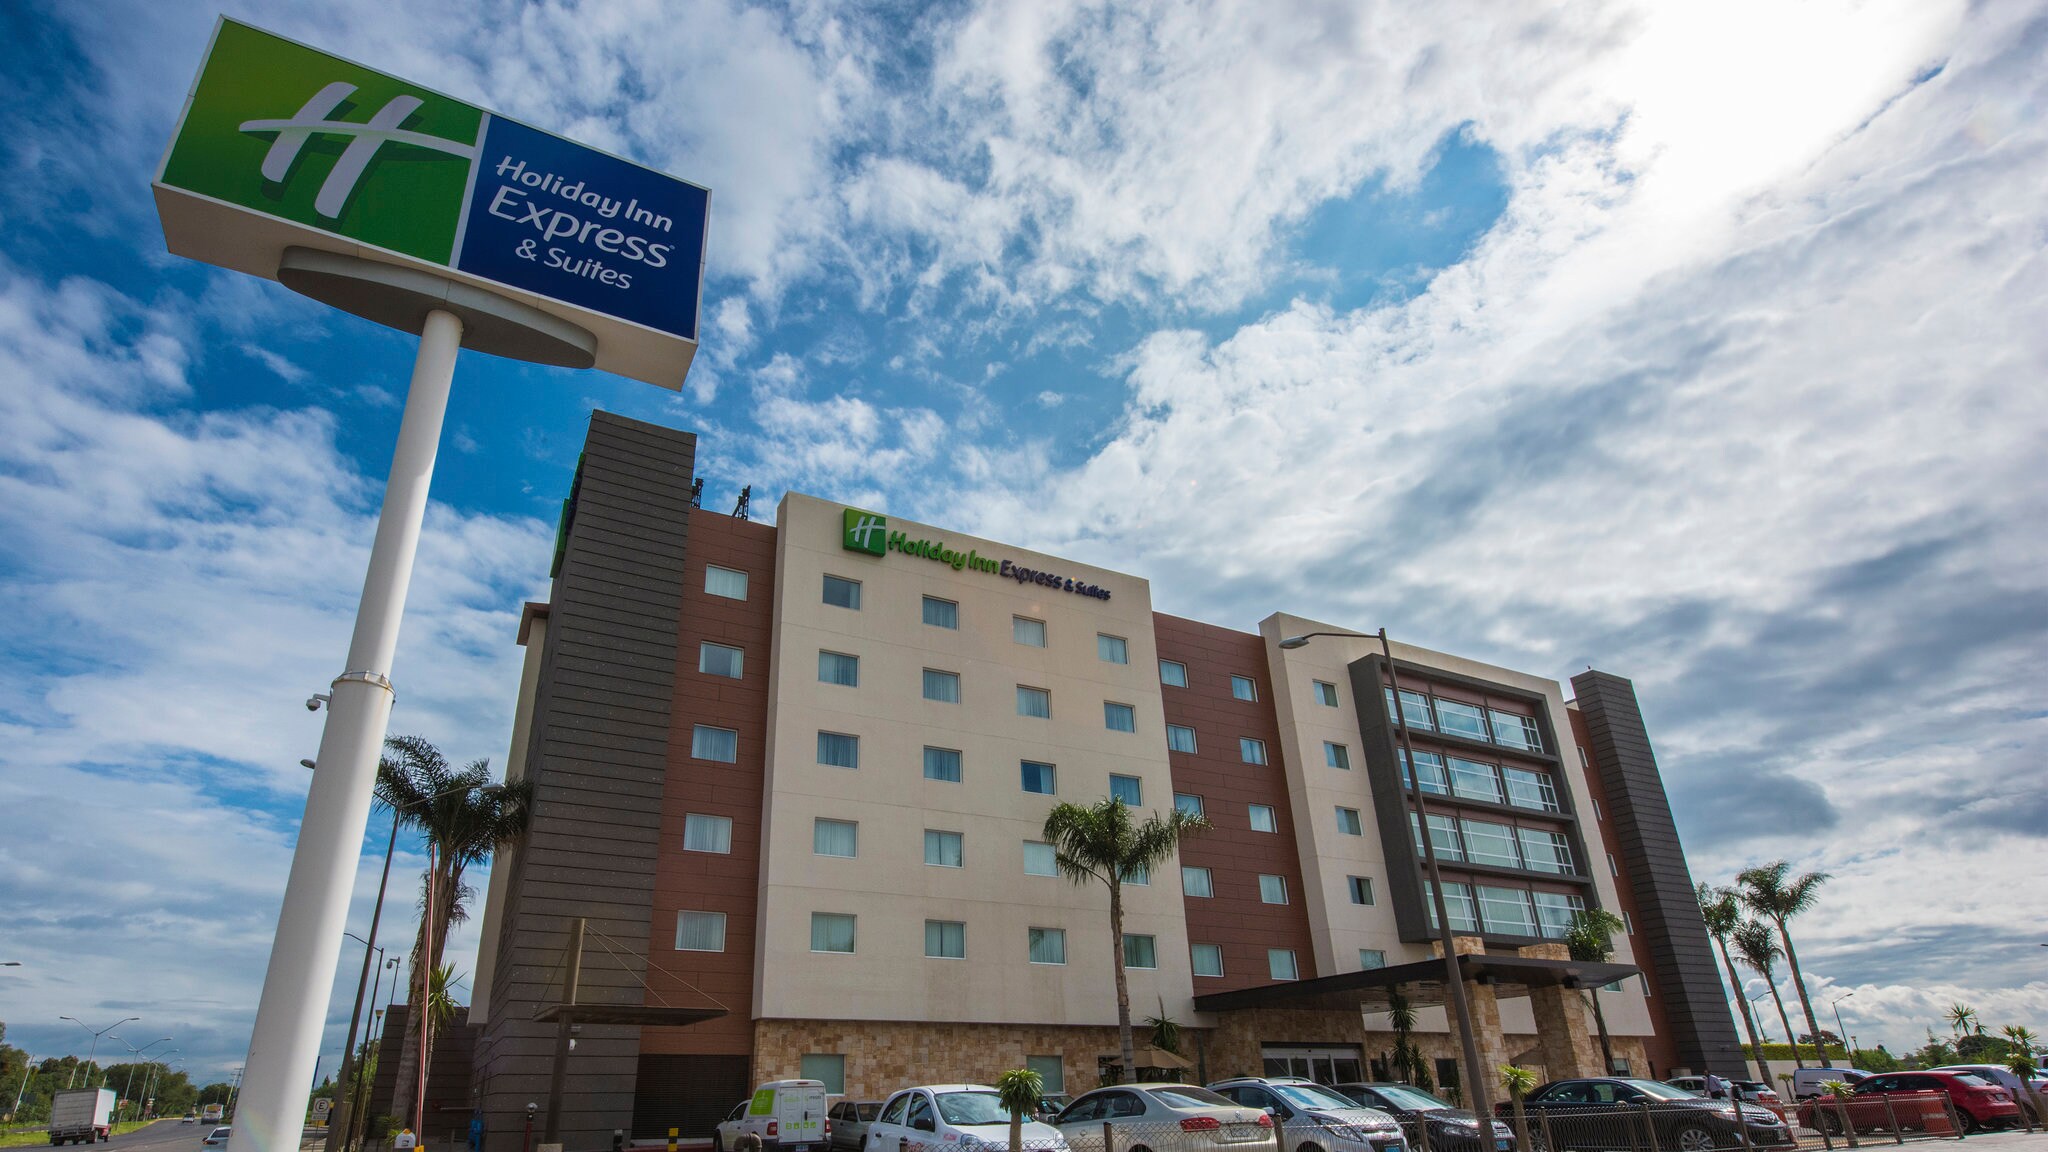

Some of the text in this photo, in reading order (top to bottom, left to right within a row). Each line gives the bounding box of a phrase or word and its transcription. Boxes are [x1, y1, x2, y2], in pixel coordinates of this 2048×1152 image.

[488, 185, 671, 269] Express
[496, 155, 673, 232] Holiday Inn
[515, 239, 633, 290] & Suites
[888, 531, 1111, 601] Holiday Inn Express & Suites
